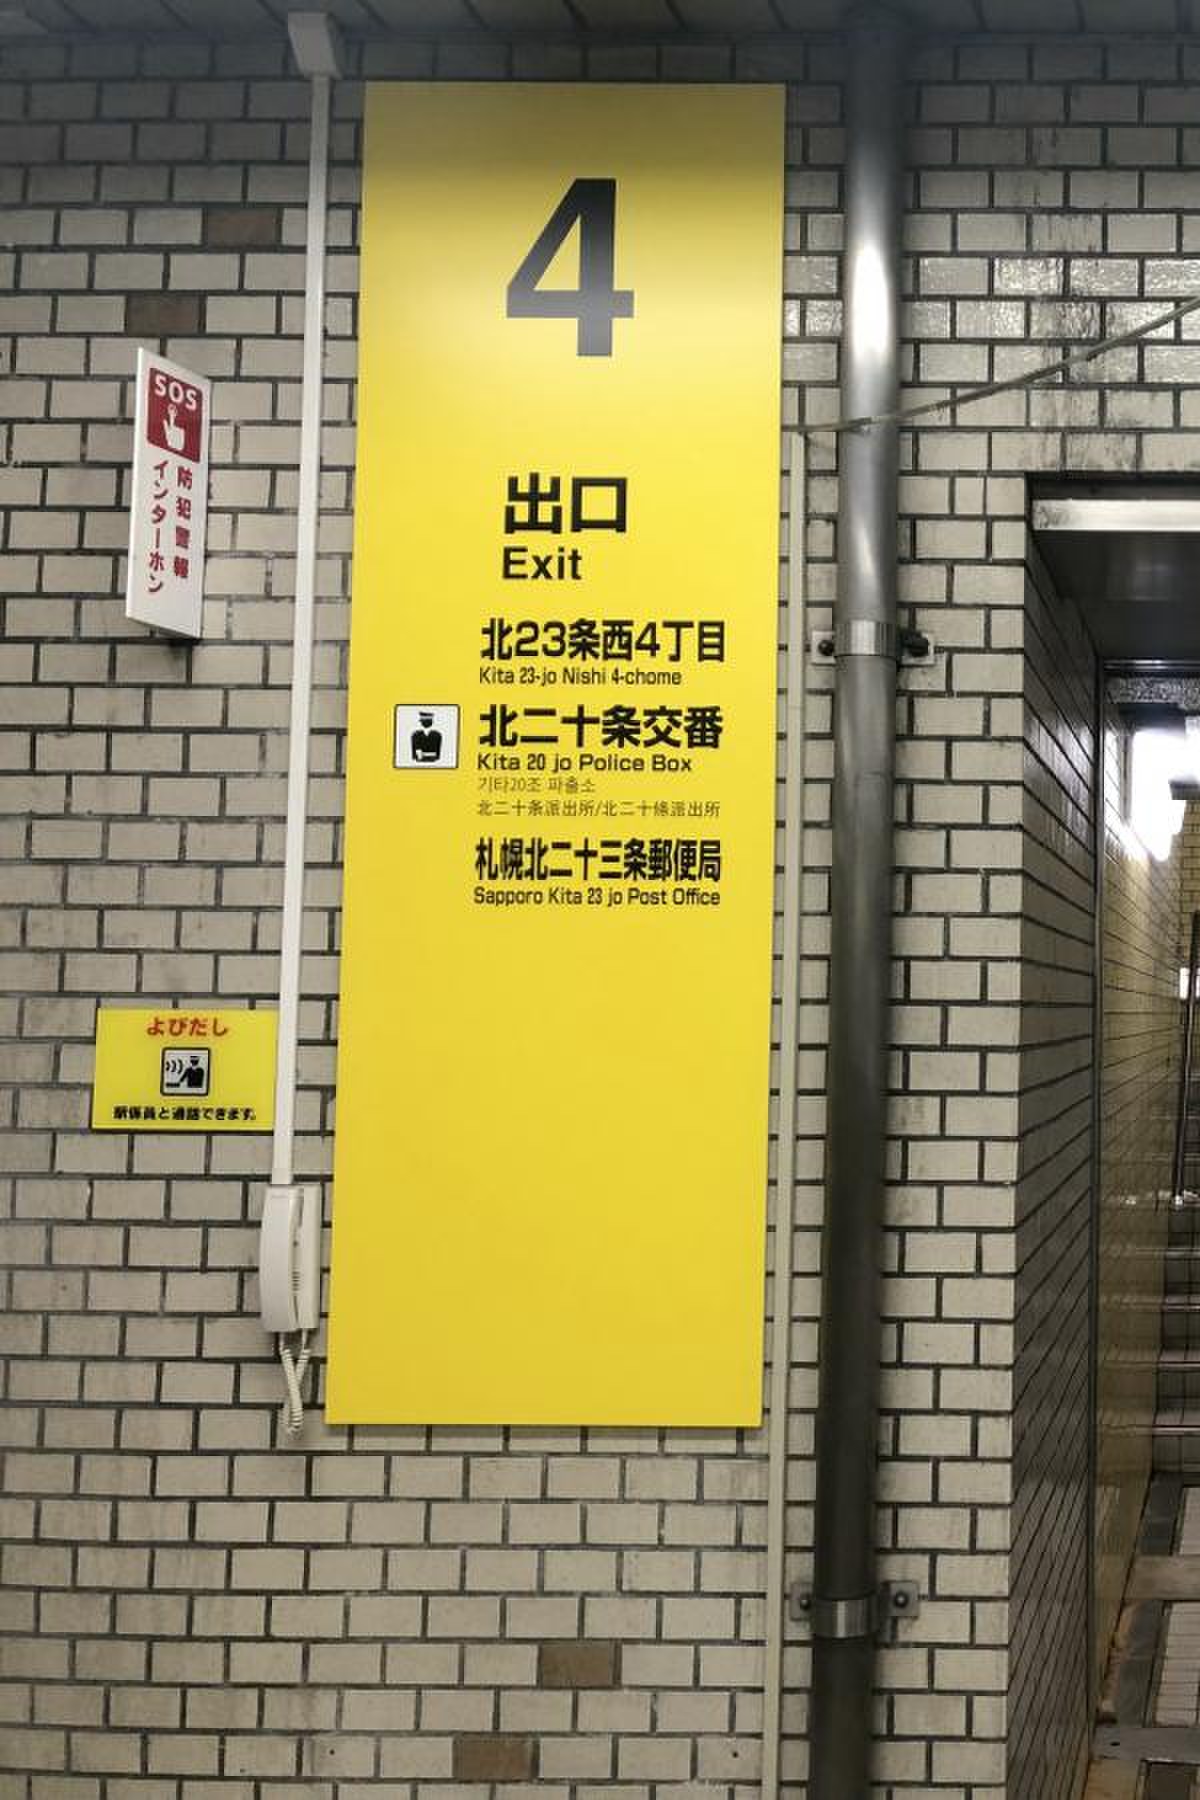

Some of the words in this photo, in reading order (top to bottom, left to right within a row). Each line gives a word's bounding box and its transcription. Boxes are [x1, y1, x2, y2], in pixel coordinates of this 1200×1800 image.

[506, 178, 635, 357] 4
[154, 374, 197, 412] SOS
[173, 466, 193, 579] 防犯警報
[504, 472, 628, 534] 出口
[148, 459, 169, 593] インターホン
[502, 546, 582, 580] Exit
[481, 618, 725, 662] 北23条西4丁目
[480, 666, 515, 685] Kita
[520, 666, 557, 687] 23-jo
[563, 667, 606, 685] Nishi
[612, 667, 682, 685] 4-chome
[480, 704, 723, 749] 北二十条交番
[478, 753, 521, 771] Kita
[527, 753, 546, 771] 20
[552, 753, 572, 774] jo
[579, 754, 645, 772] Police
[652, 754, 692, 772] Box
[478, 776, 541, 794] 기타20조
[548, 776, 596, 794] 파출소
[474, 838, 721, 882] 札幌北二十三条郵便局
[474, 886, 543, 907] Sapporo
[549, 887, 583, 905] Kita
[587, 887, 602, 905] 23
[608, 888, 623, 907] jo
[628, 888, 667, 906] Post
[672, 888, 720, 906] Office
[146, 1017, 228, 1036] よびだし
